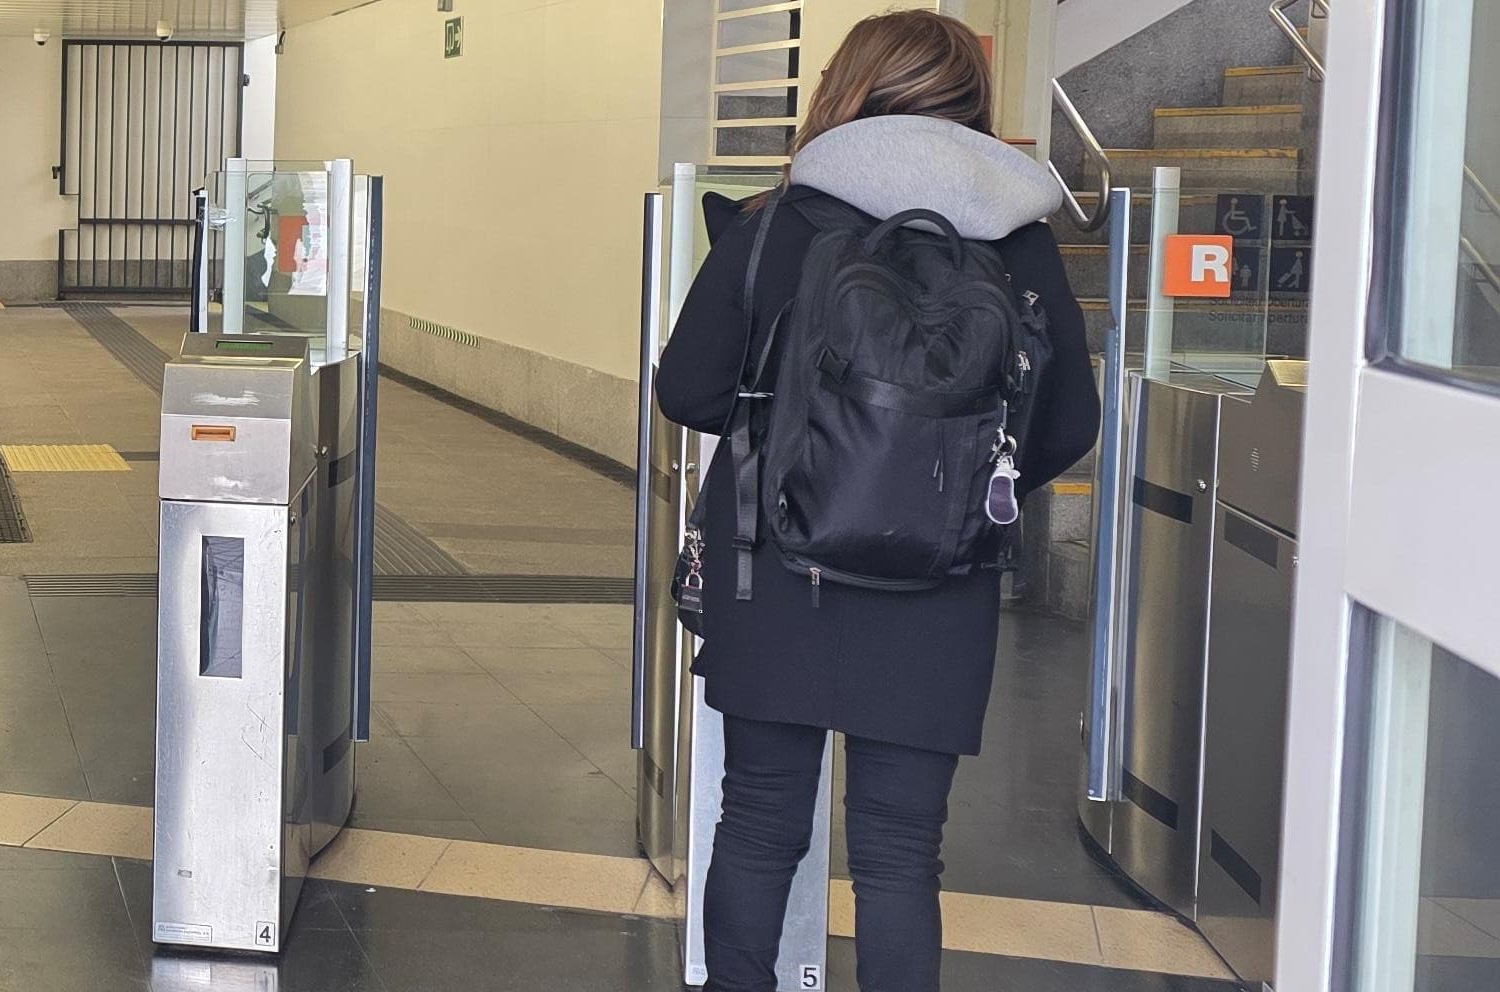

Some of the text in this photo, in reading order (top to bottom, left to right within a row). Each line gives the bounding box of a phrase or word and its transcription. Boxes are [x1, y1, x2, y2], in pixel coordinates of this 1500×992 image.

[1191, 244, 1229, 282] R
[259, 925, 271, 943] 4
[803, 967, 817, 988] 5
